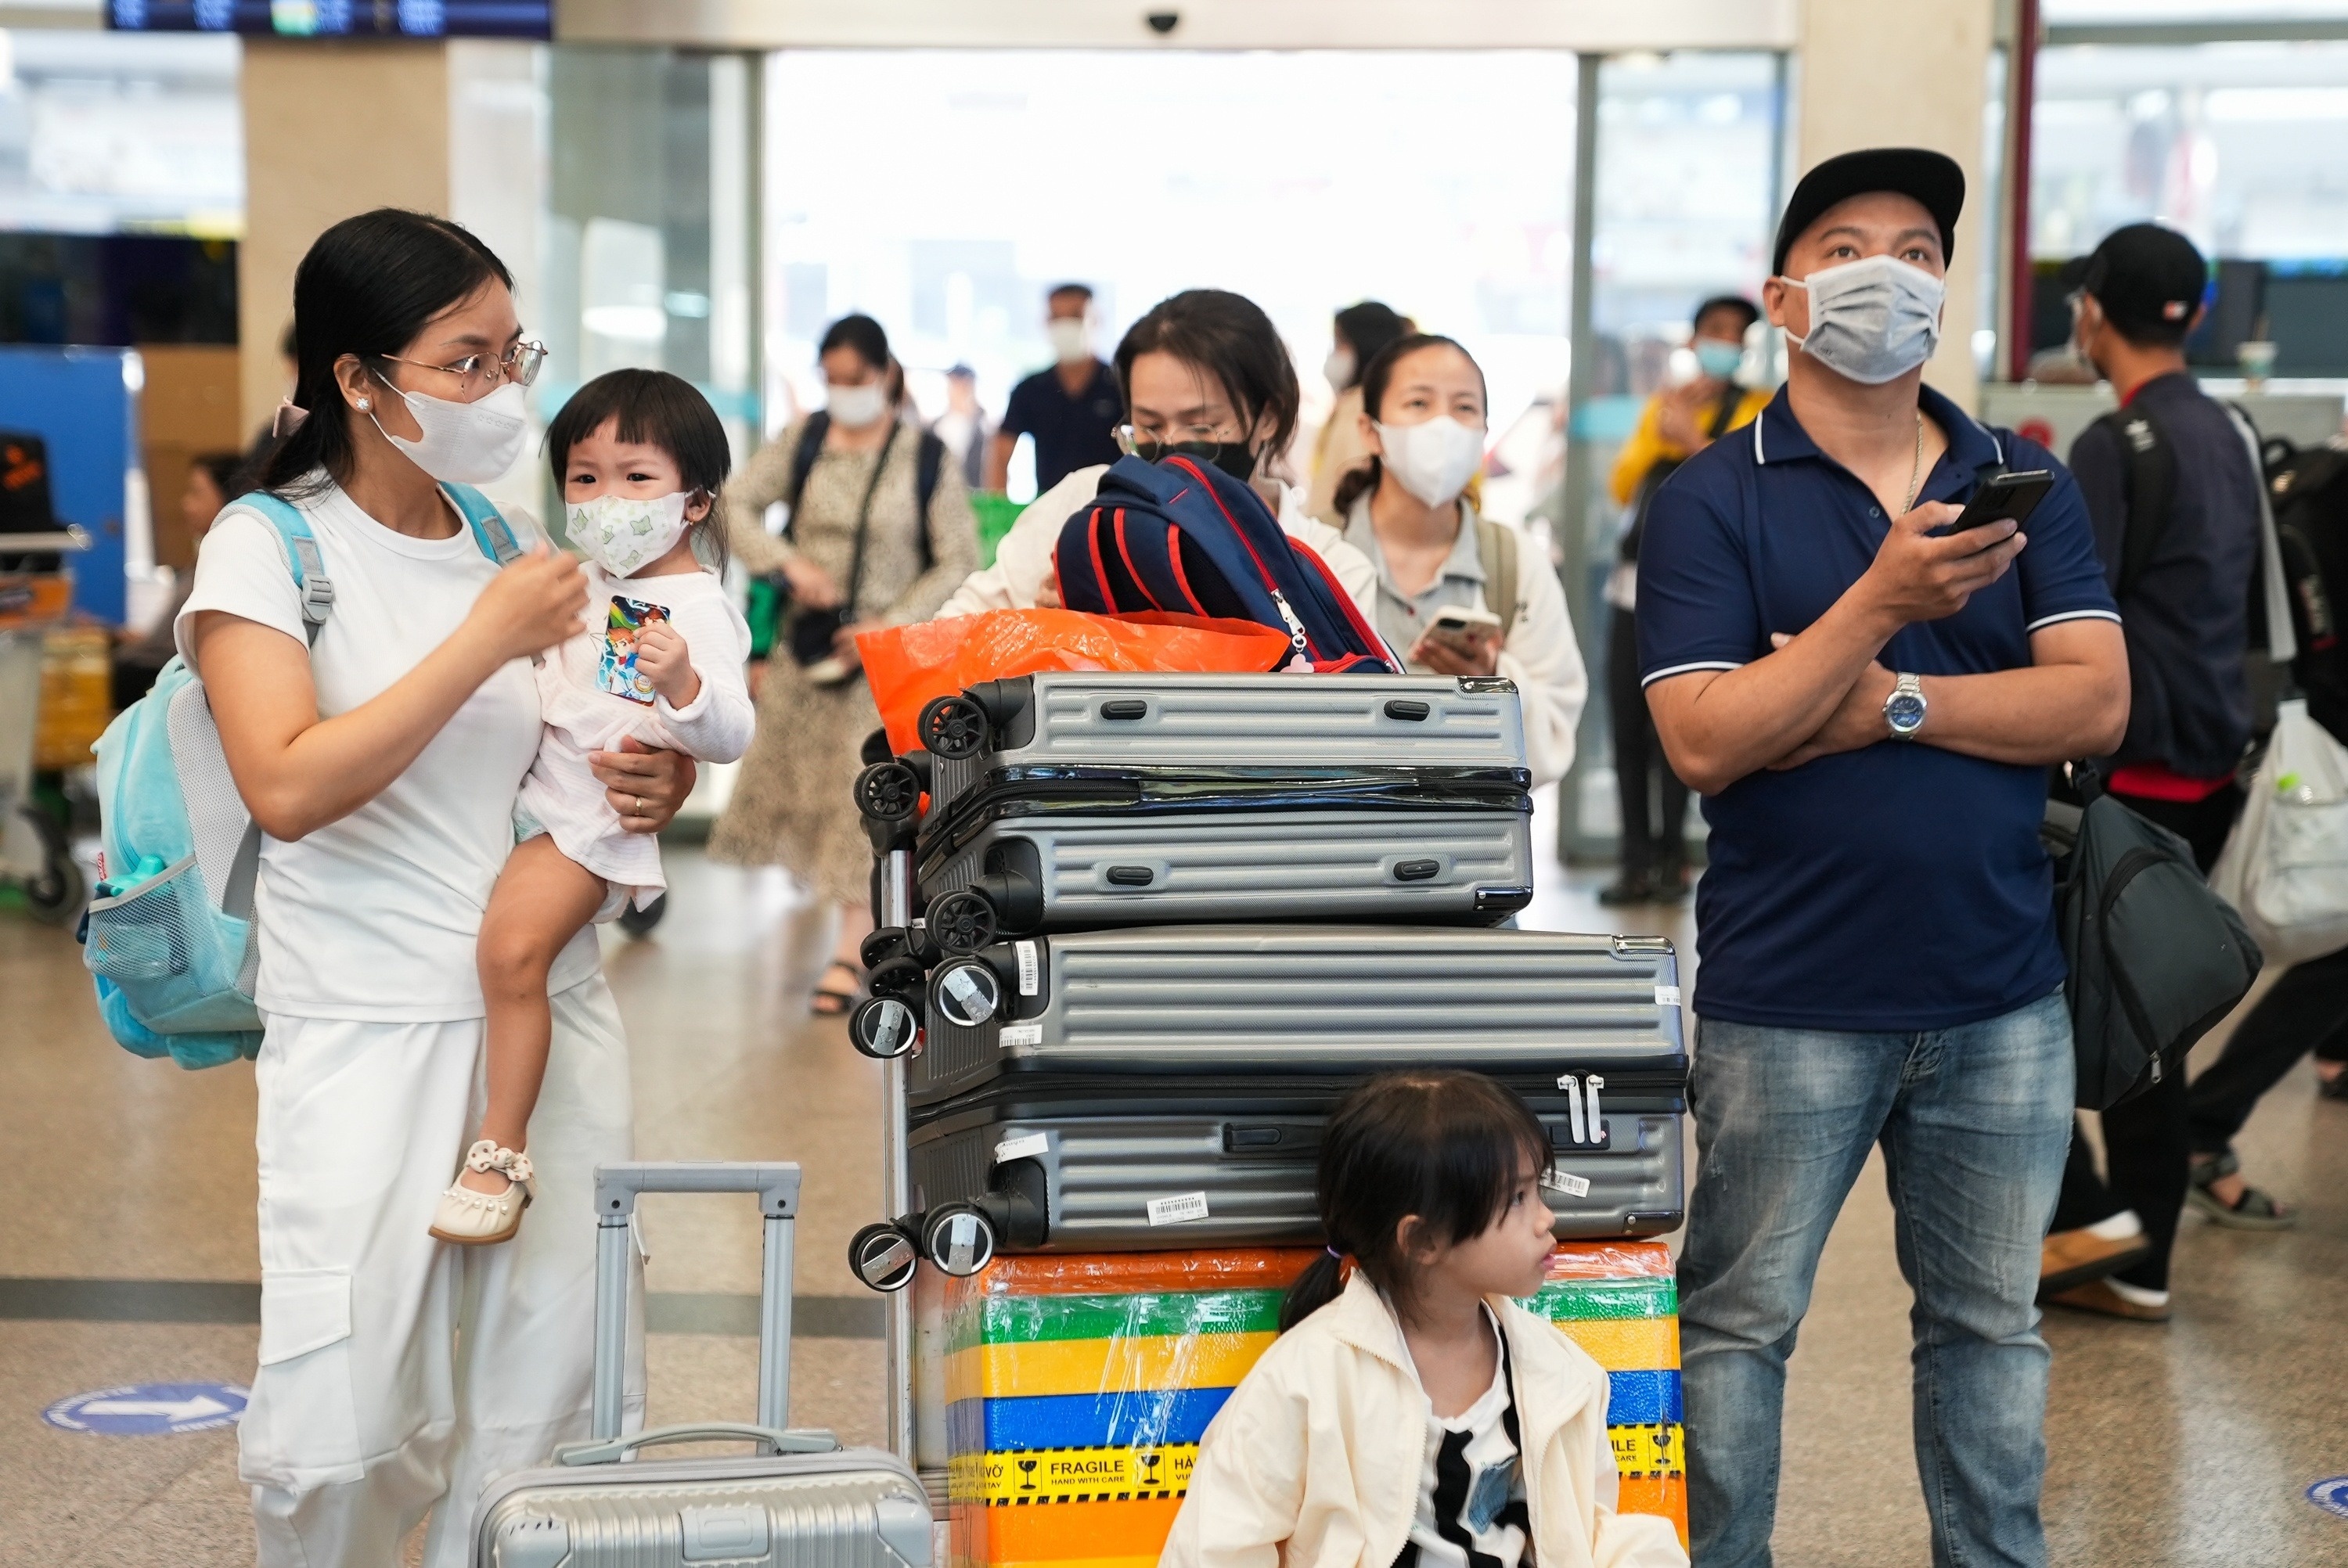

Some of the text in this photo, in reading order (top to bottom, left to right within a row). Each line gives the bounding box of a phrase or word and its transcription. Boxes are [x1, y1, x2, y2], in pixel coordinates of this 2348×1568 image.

[1612, 1439, 1637, 1451] ILE
[1051, 1460, 1124, 1475] FRAGILE
[1175, 1455, 1197, 1470] HÀ
